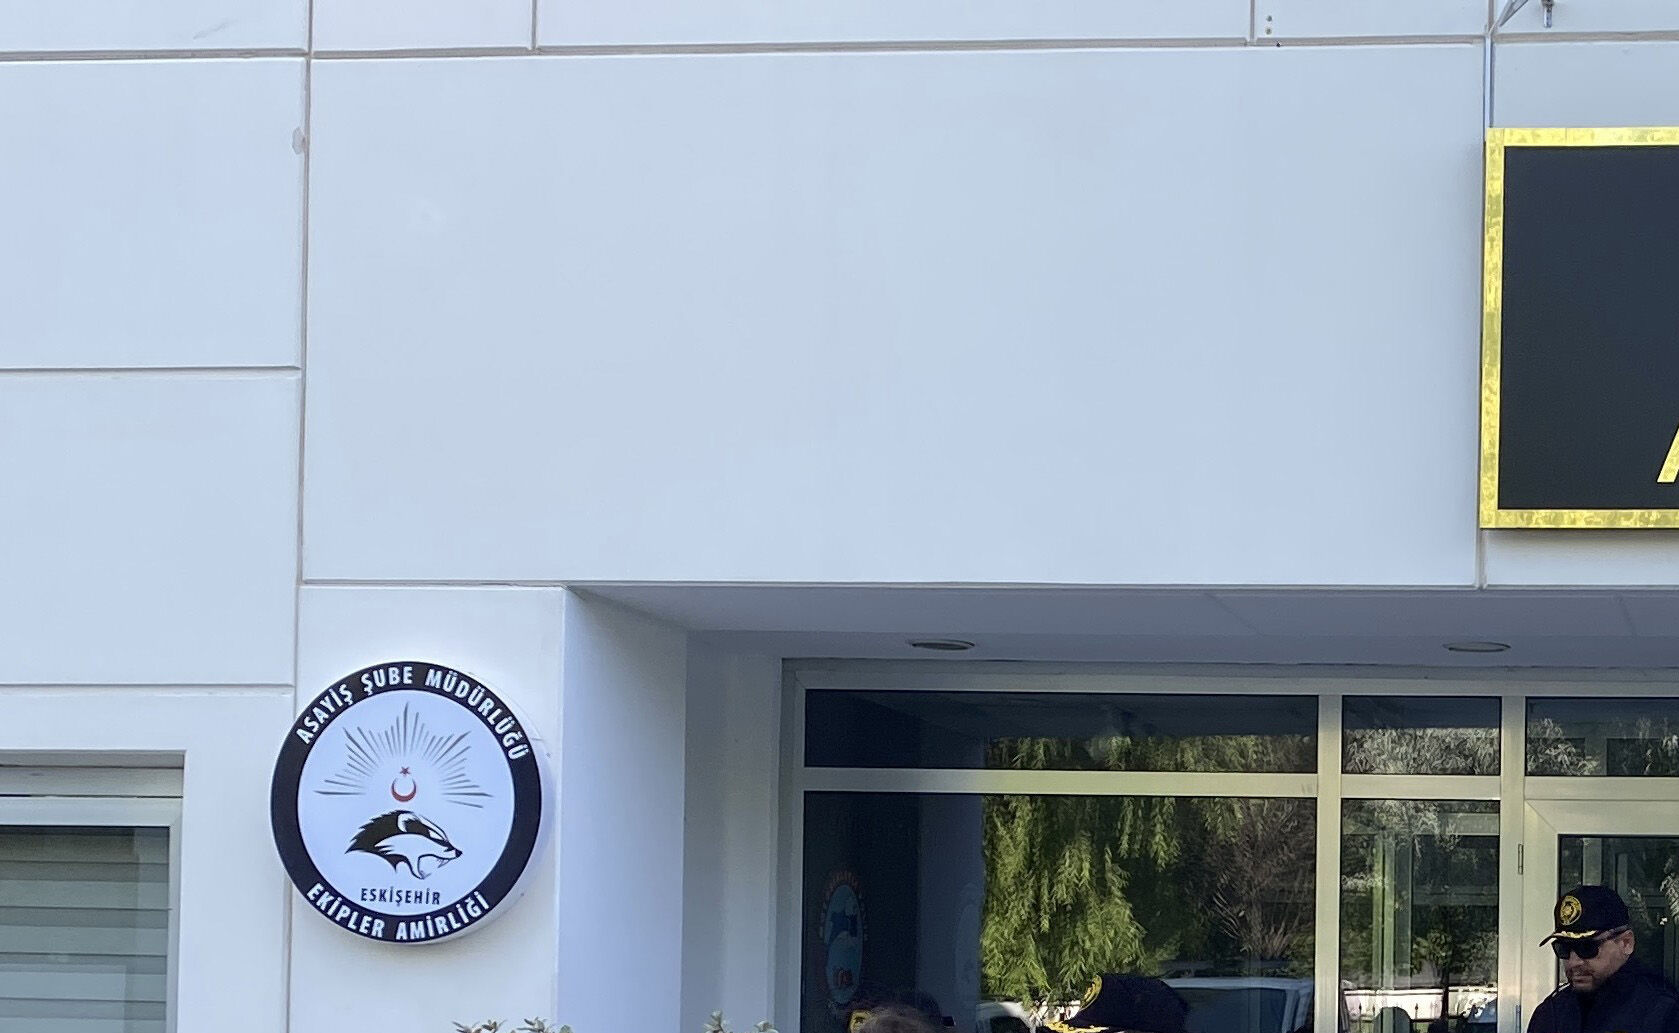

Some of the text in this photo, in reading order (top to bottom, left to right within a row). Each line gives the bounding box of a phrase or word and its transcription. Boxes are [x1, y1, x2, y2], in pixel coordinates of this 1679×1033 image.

[296, 666, 529, 761] ASAYİŞ ŞUBE MÜDÜRLÜĞÜ
[306, 882, 490, 940] EKİPLER AMİRLİĞİ
[360, 886, 441, 907] ESKİŞEHİR
